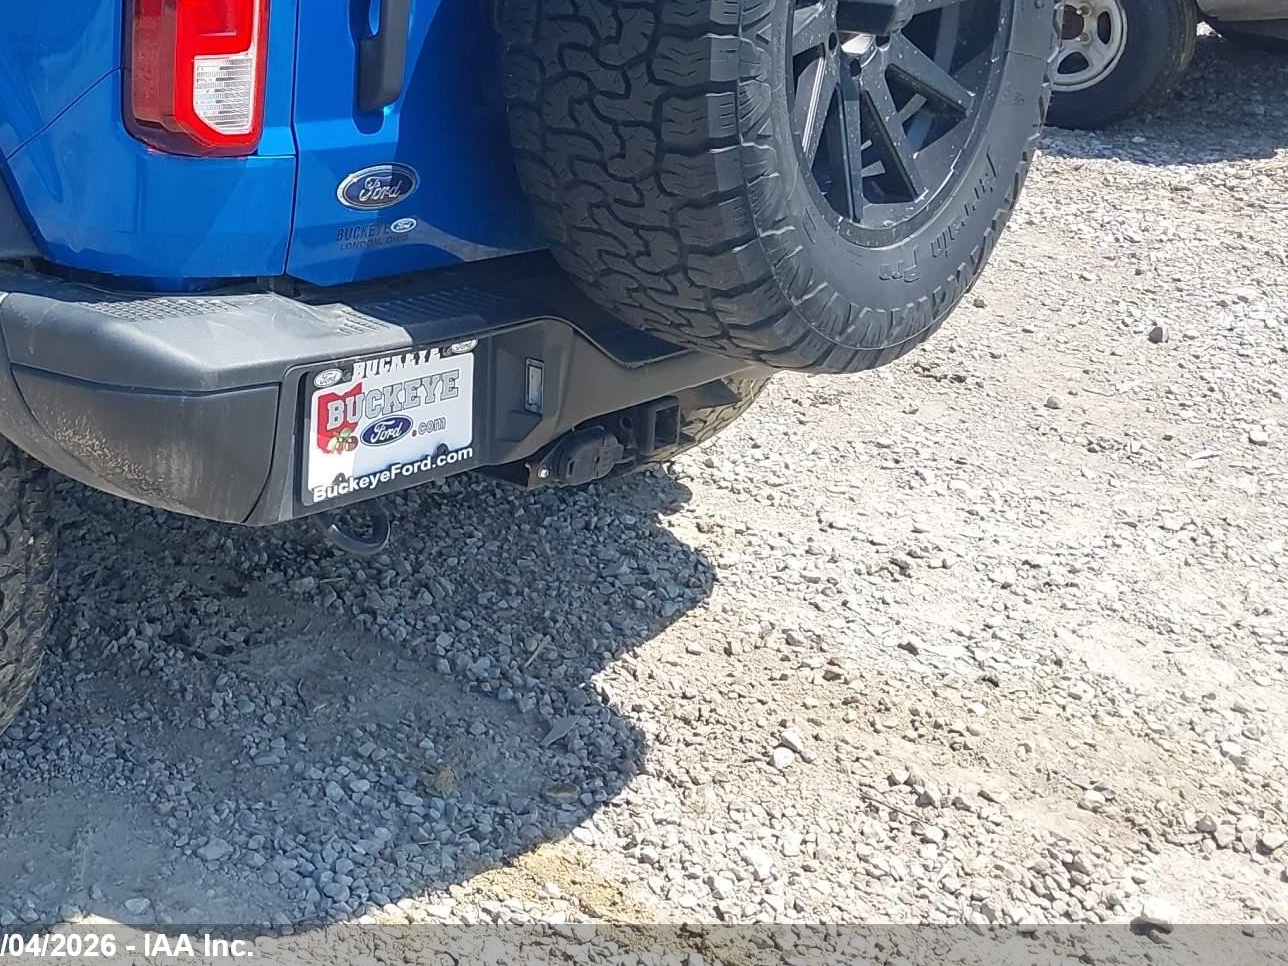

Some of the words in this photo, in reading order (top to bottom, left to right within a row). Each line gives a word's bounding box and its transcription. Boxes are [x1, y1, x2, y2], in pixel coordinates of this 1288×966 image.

[358, 175, 402, 202] Ford
[336, 221, 393, 241] BUCKEYE
[327, 369, 460, 430] BUCKEYE
[369, 419, 403, 443] Ford
[313, 447, 473, 503] BuckeyeFord.com
